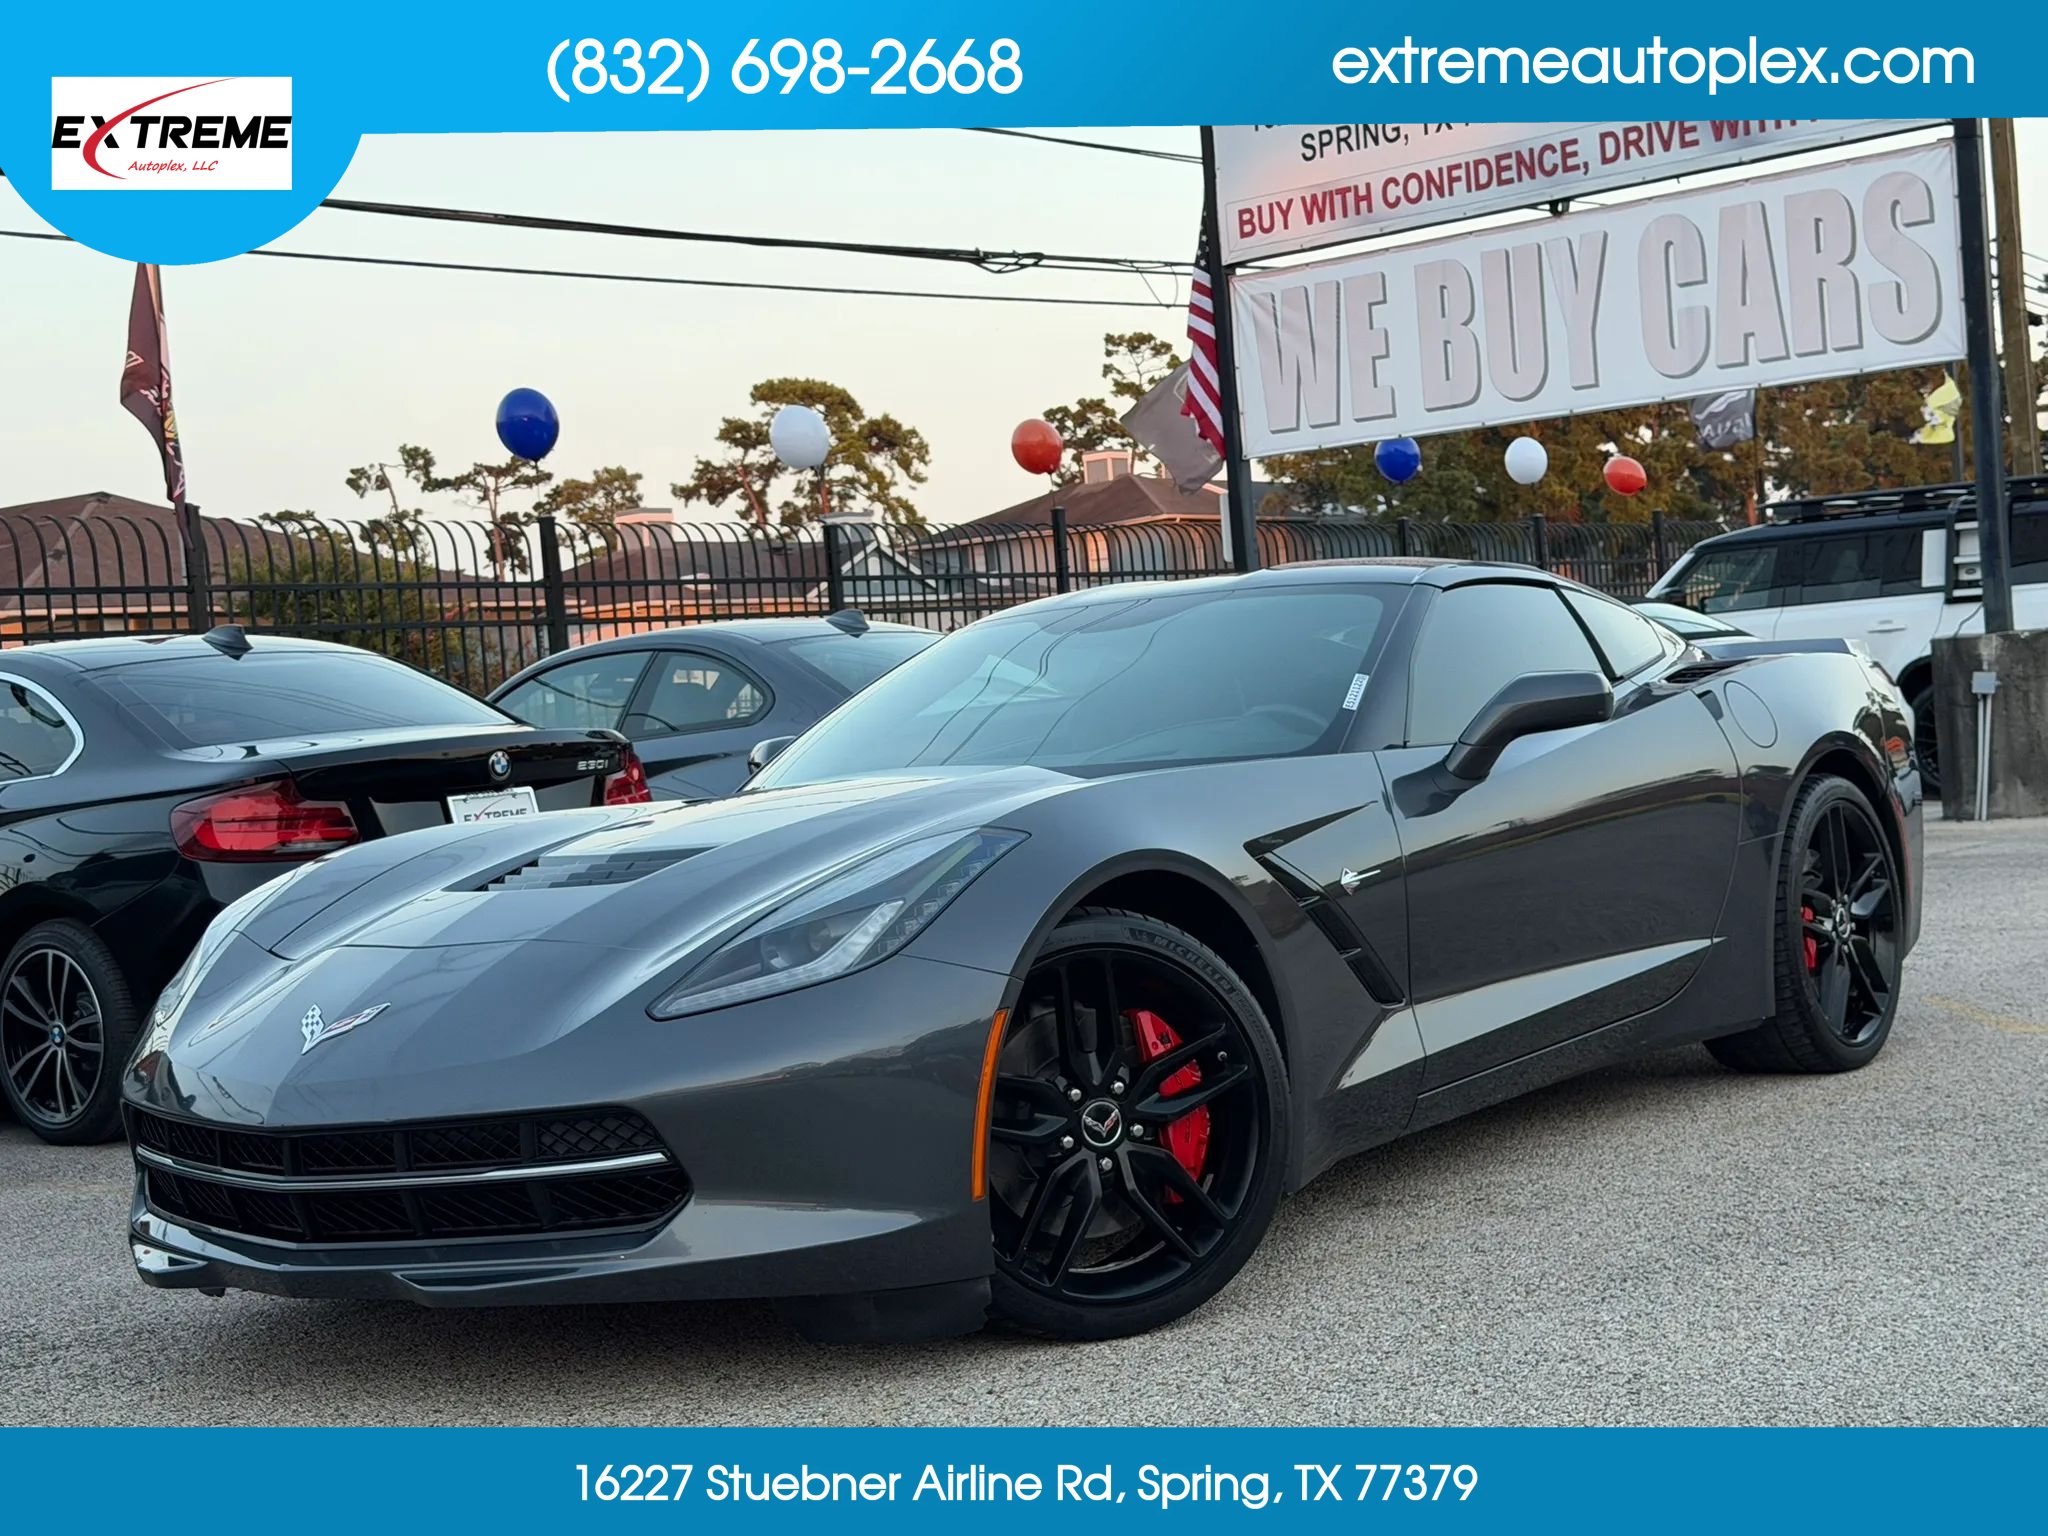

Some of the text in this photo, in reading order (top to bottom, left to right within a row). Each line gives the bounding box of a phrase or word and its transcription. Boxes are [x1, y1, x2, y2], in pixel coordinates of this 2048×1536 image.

[1237, 198, 1294, 239] BUY
[1301, 182, 1373, 226] WITH
[1381, 138, 1590, 209] CONFIDENCE,
[1600, 121, 1699, 165] DRIVE
[1301, 124, 1409, 162] SPRING,
[1257, 170, 1943, 433] WE BUY CARS
